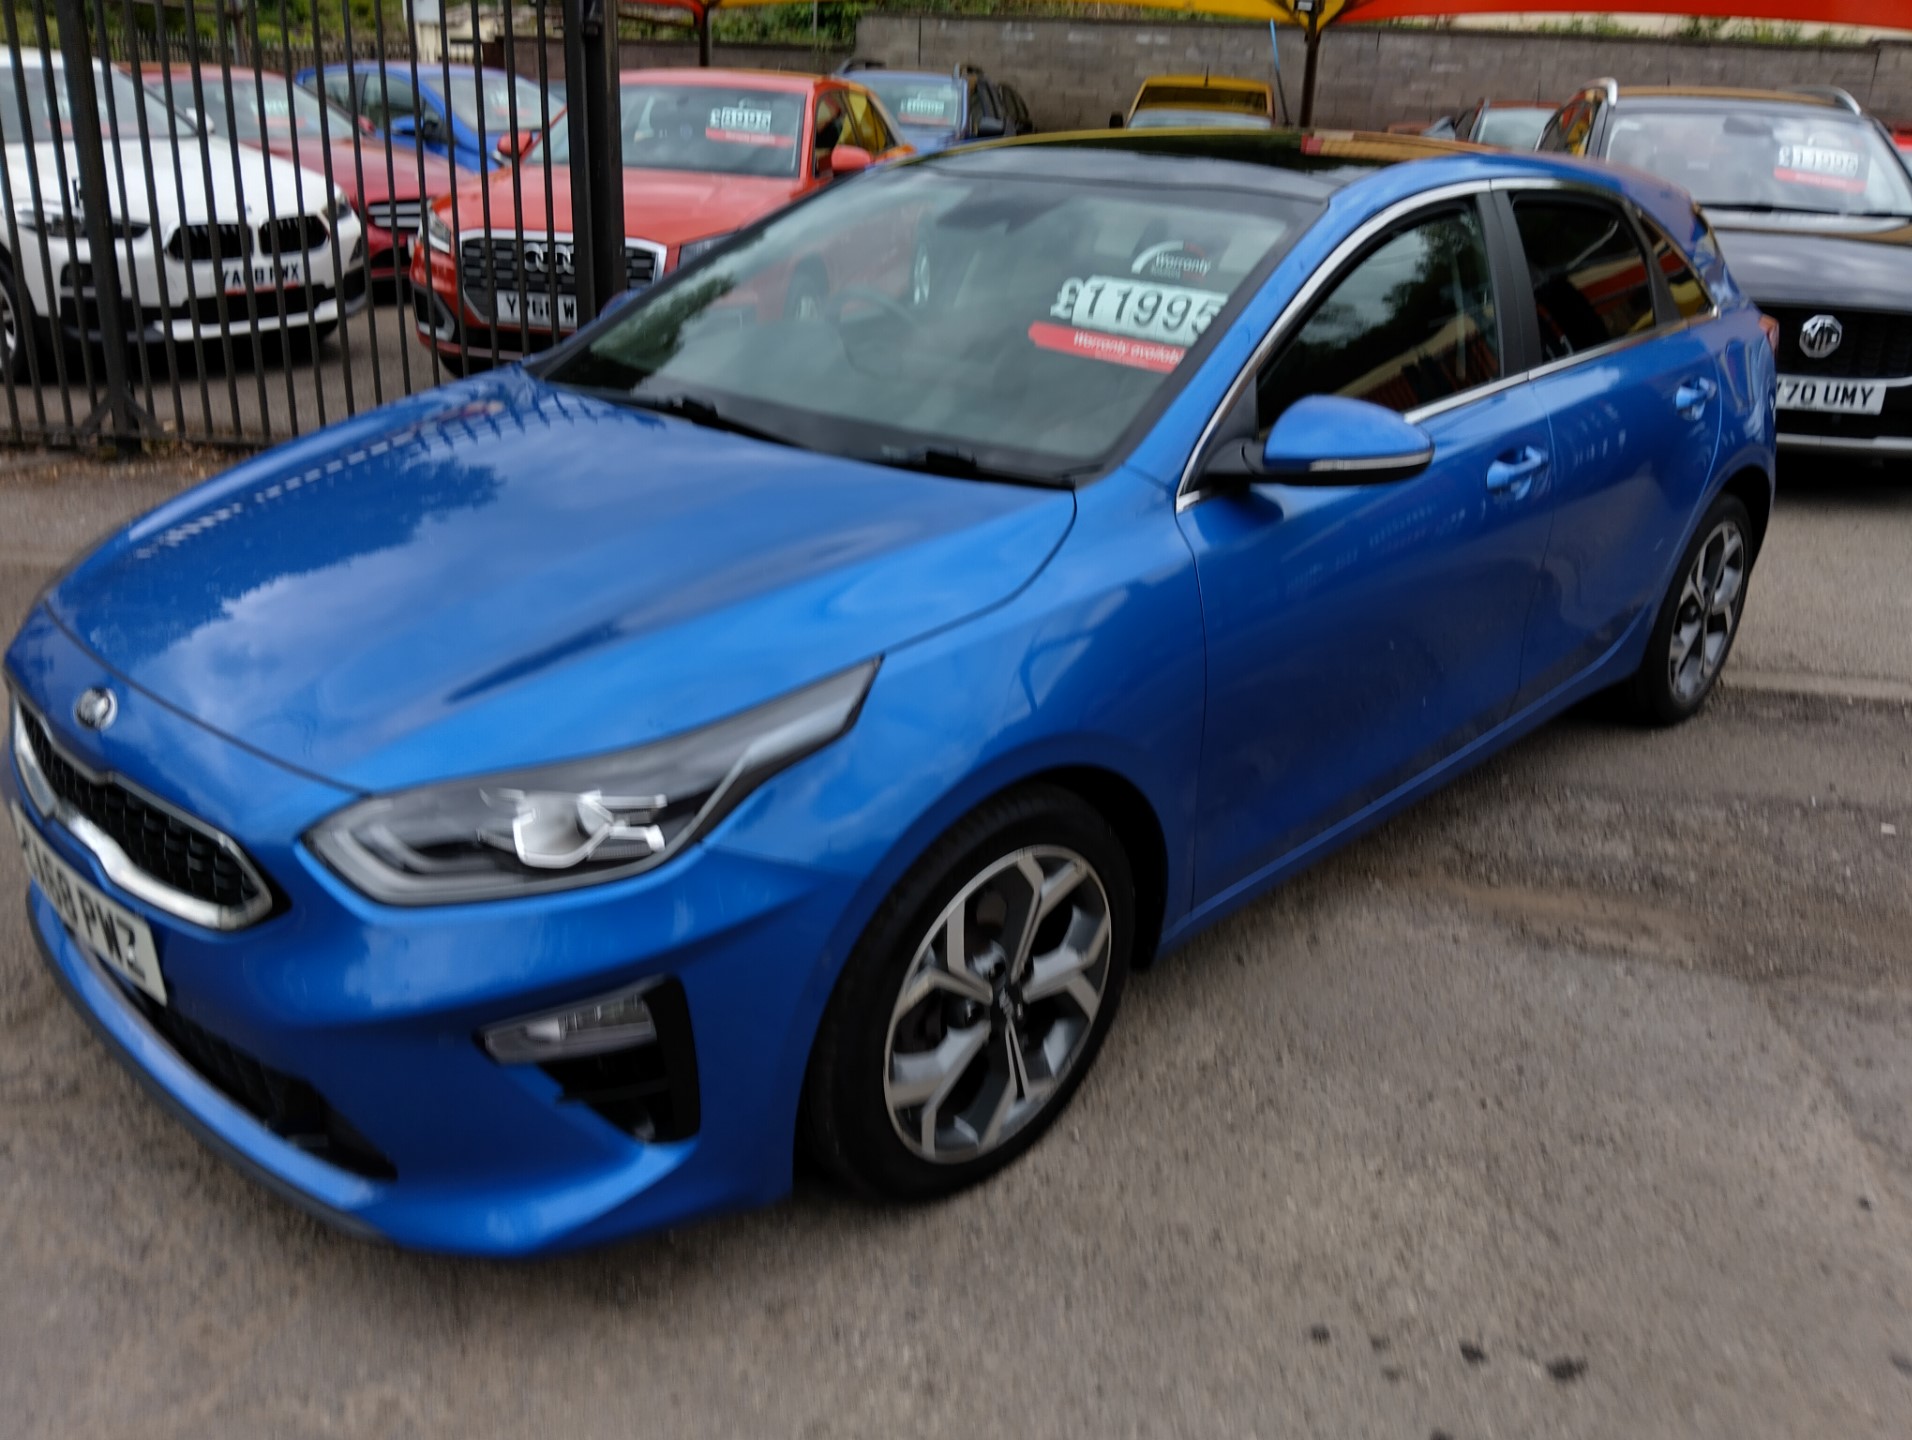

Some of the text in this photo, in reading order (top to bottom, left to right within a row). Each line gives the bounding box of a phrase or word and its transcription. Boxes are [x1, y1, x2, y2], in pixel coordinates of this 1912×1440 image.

[1051, 277, 1223, 336] £11995
[1777, 381, 1874, 408] 70 UMY
